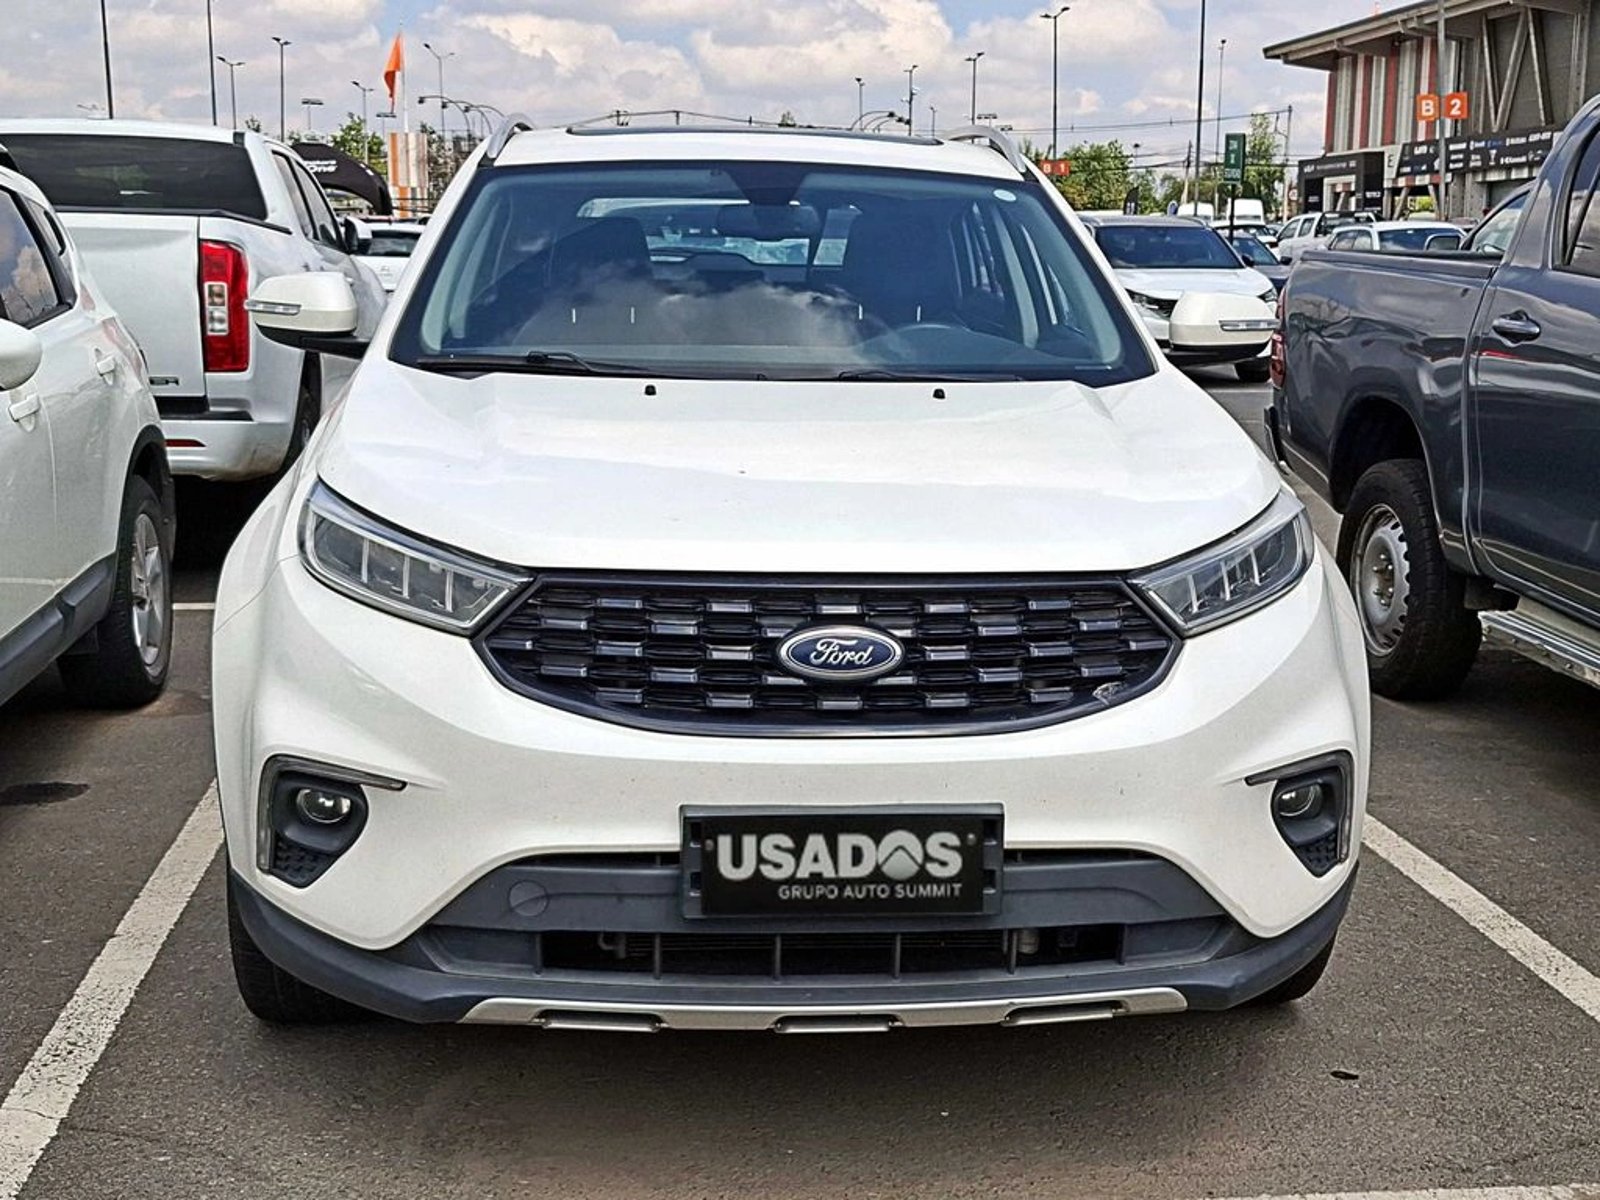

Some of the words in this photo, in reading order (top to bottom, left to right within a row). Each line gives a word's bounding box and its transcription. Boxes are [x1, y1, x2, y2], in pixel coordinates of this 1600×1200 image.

[1421, 99, 1434, 117] B
[1449, 98, 1462, 116] 2
[809, 638, 874, 665] Ford
[716, 830, 963, 881] USADOS
[778, 884, 838, 900] GRUPO
[843, 884, 889, 899] AUTO
[894, 883, 963, 899] SUMMIT
